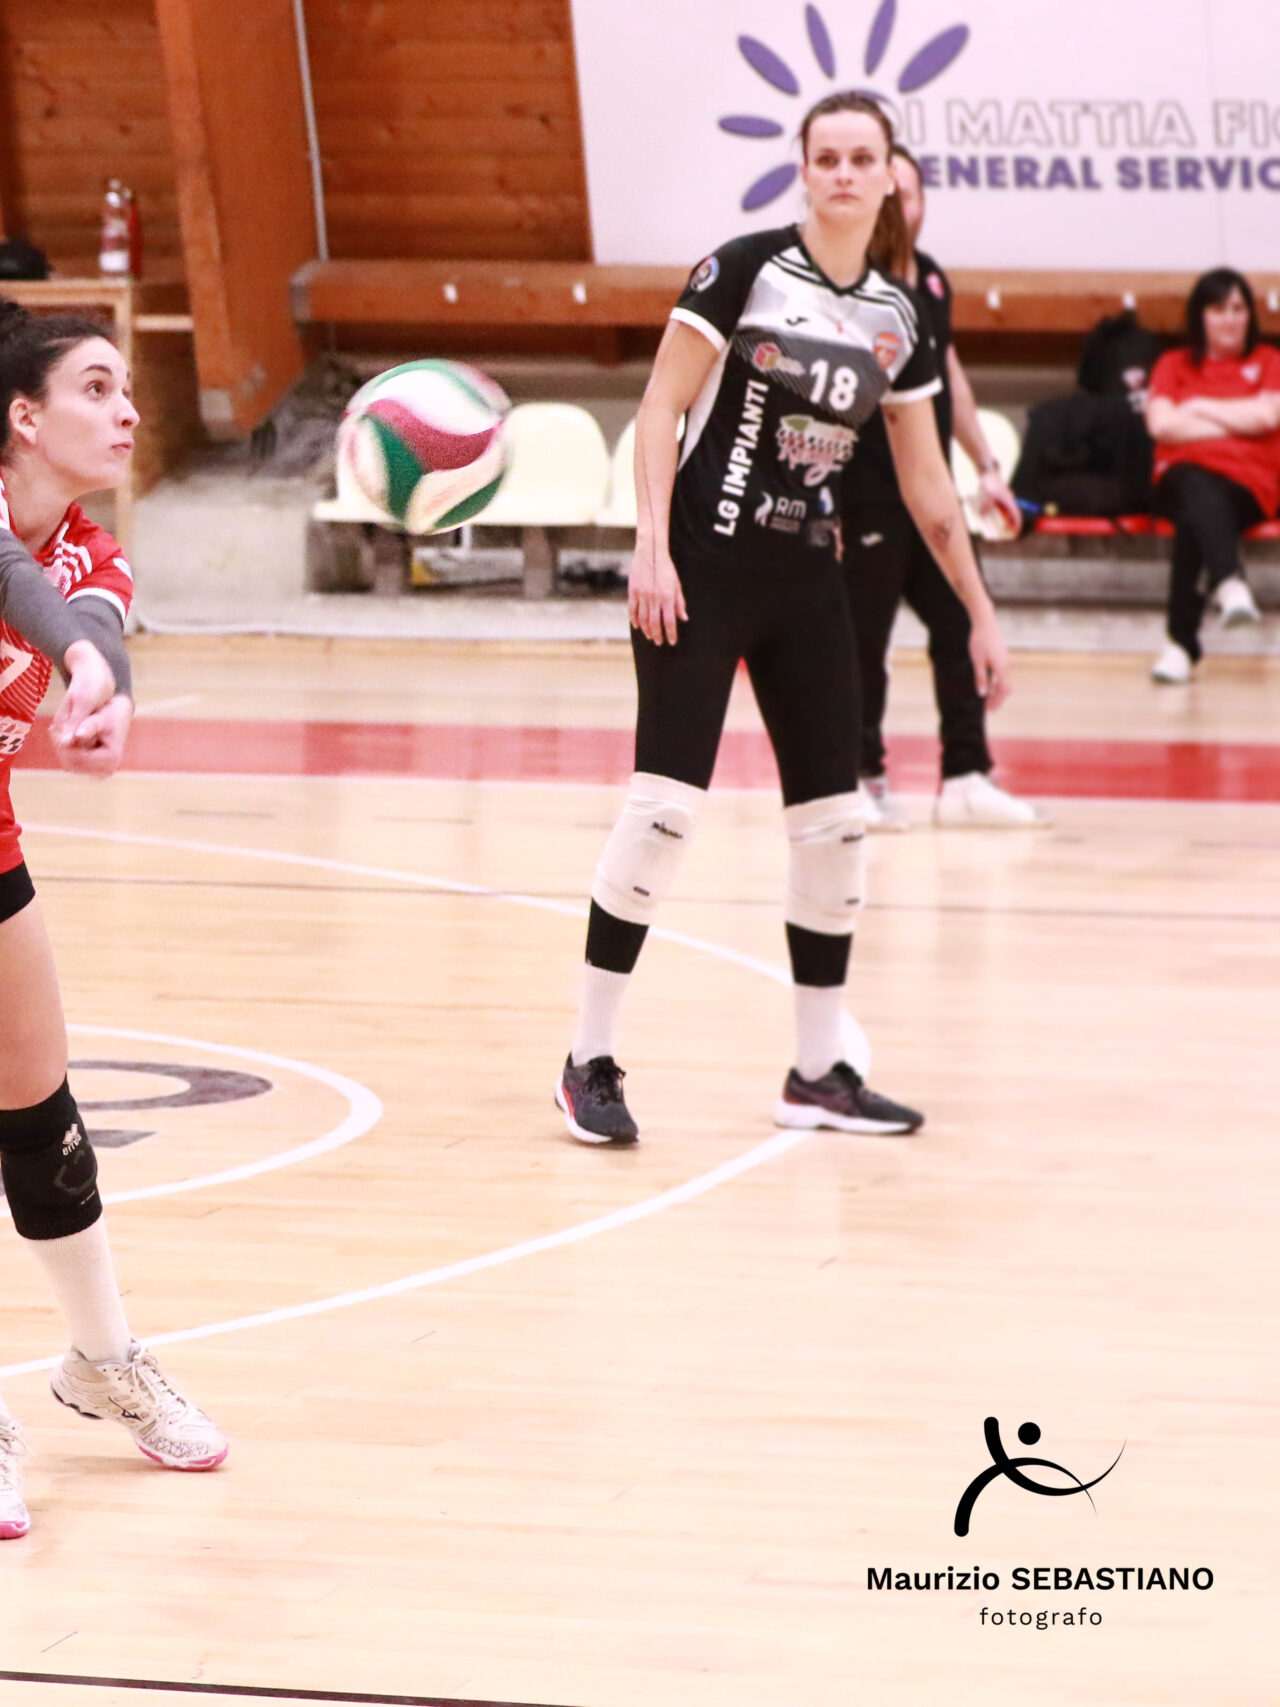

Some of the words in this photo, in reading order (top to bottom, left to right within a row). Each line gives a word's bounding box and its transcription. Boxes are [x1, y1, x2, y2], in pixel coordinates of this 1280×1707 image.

[945, 98, 1196, 149] MATTIA
[1212, 98, 1280, 150] FI
[918, 155, 1102, 190] ENERAL
[809, 358, 859, 411] 18
[722, 379, 769, 497] IMPIANTI
[714, 499, 741, 536] LG
